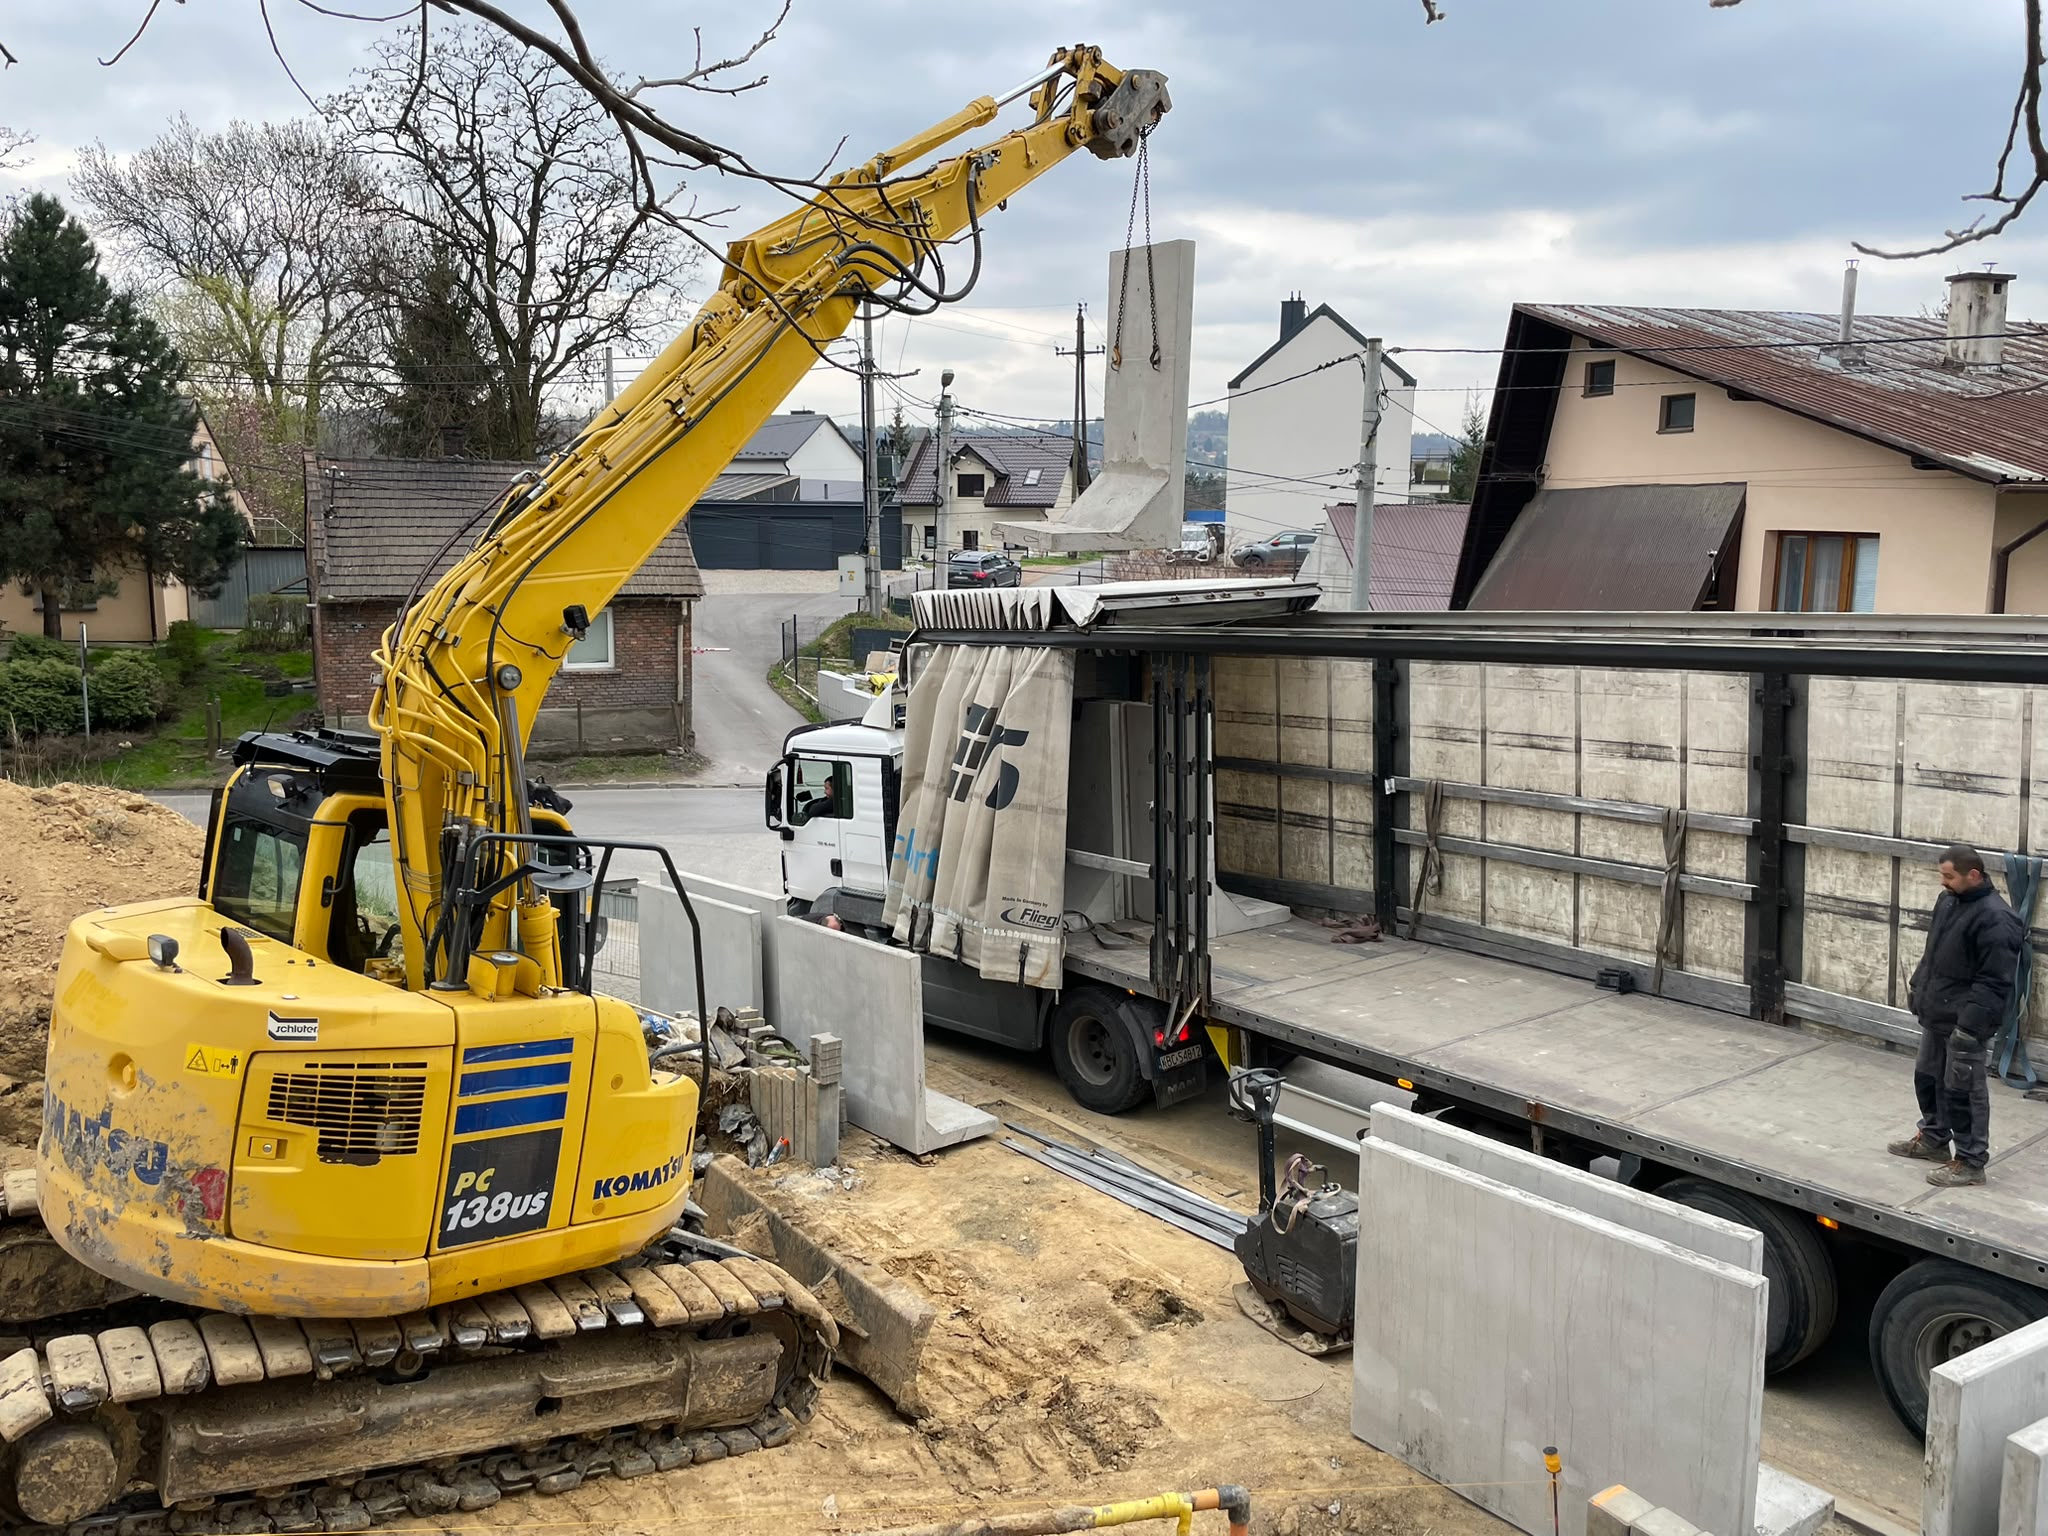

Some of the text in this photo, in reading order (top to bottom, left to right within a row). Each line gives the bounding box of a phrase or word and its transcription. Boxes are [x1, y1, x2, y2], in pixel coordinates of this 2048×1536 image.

[1019, 907, 1062, 929] Fliegl
[451, 1167, 496, 1197] PC
[592, 1153, 685, 1201] KOMATSU
